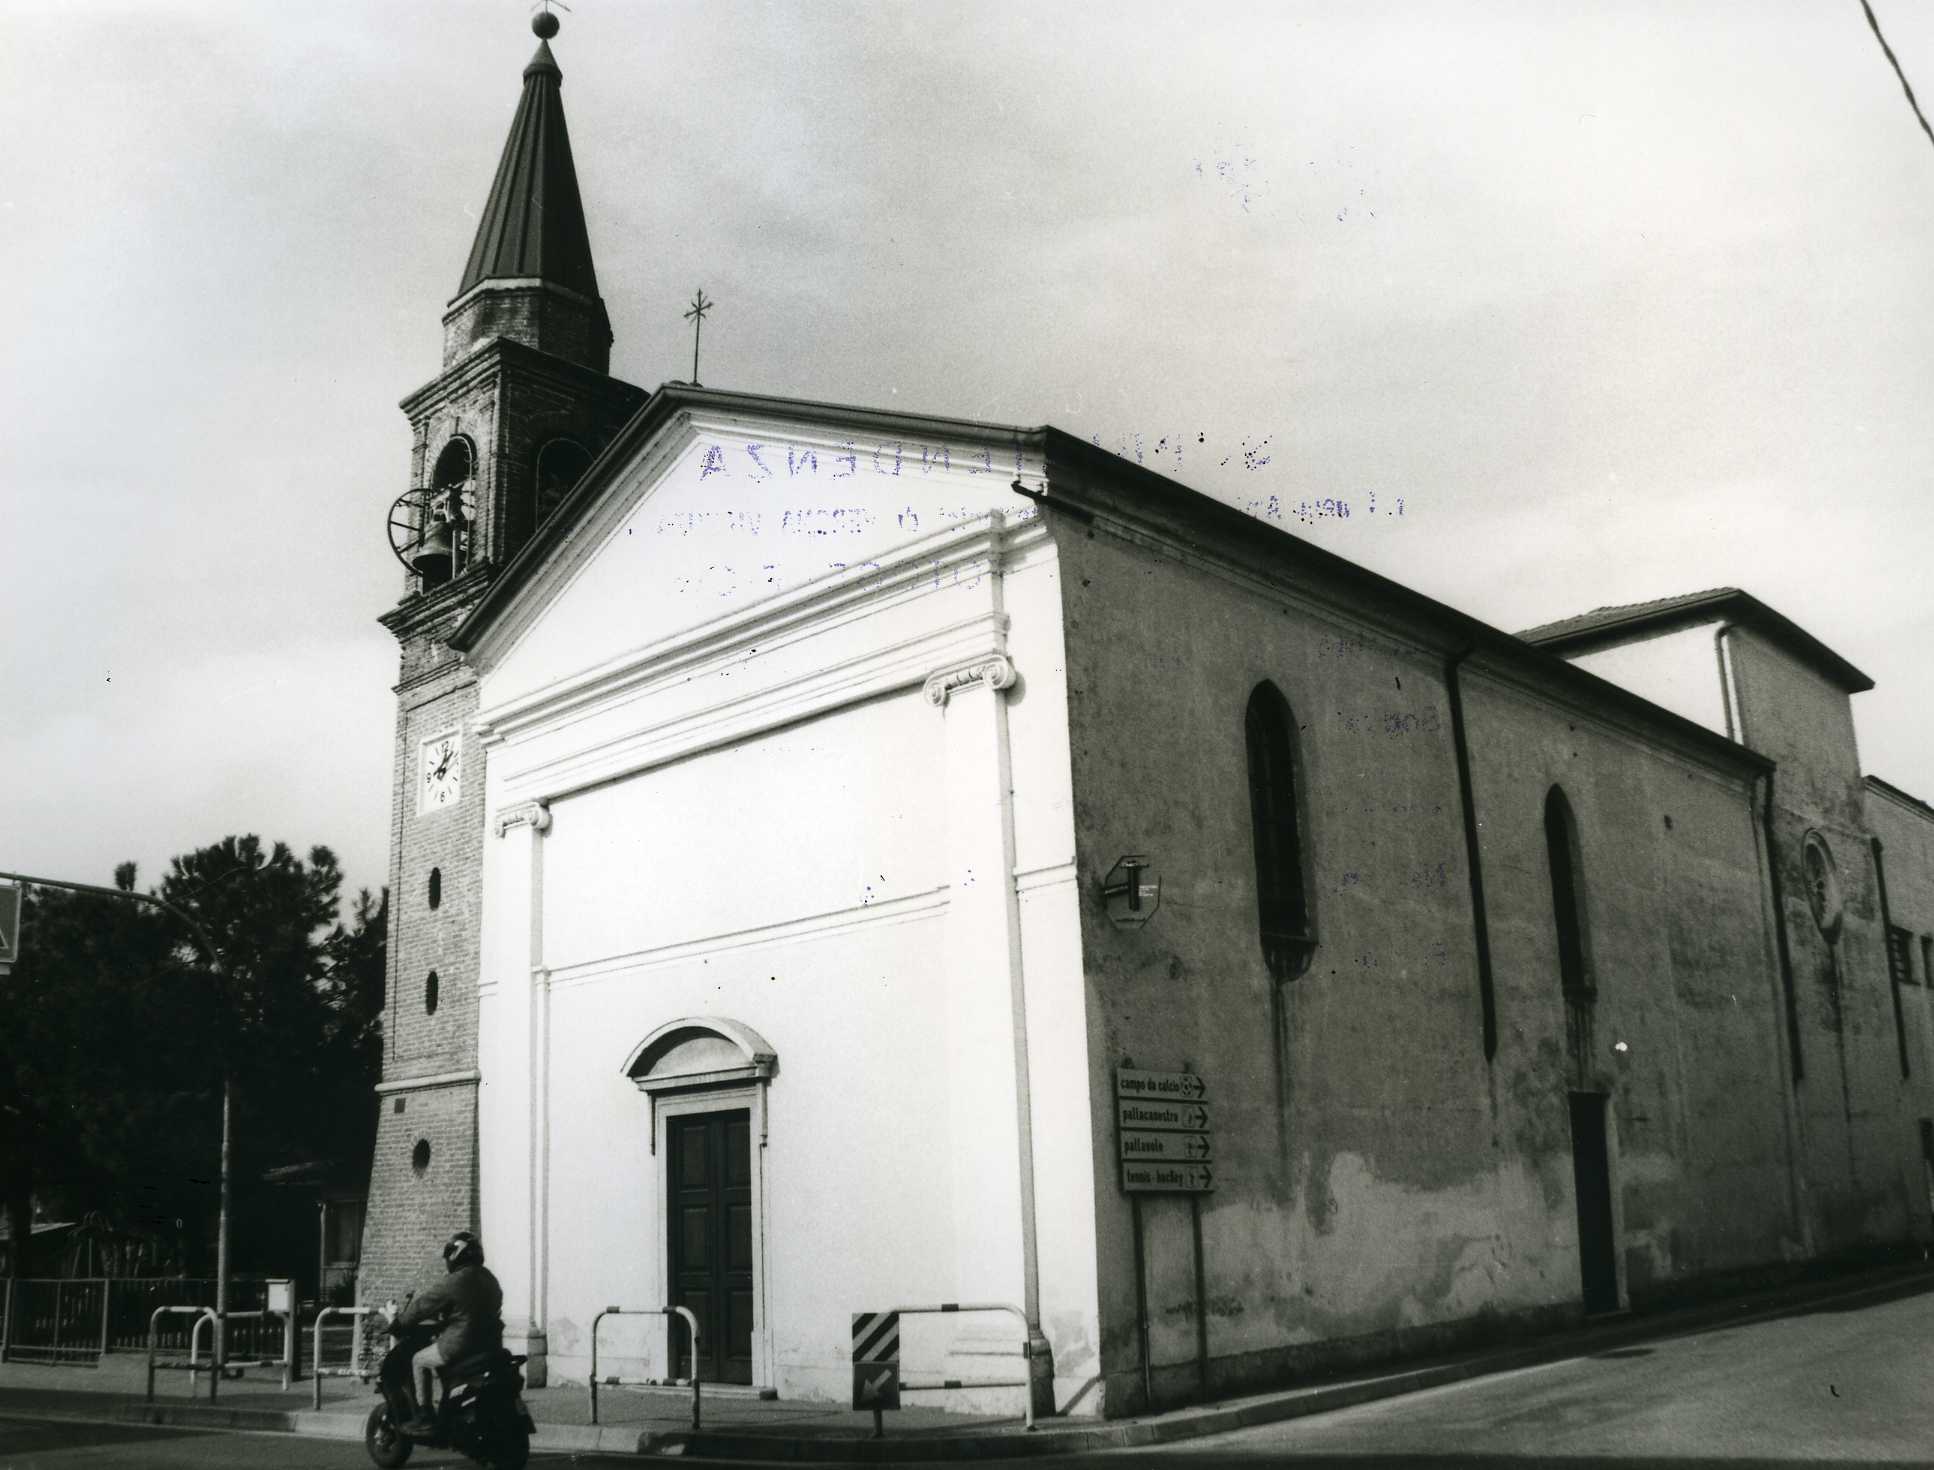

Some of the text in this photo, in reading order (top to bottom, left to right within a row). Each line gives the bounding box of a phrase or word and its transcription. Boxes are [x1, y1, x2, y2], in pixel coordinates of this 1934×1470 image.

[1120, 1077, 1180, 1093] campo da calcio
[1123, 1107, 1178, 1123] pallacanestro
[1124, 1137, 1163, 1155] pallavolo
